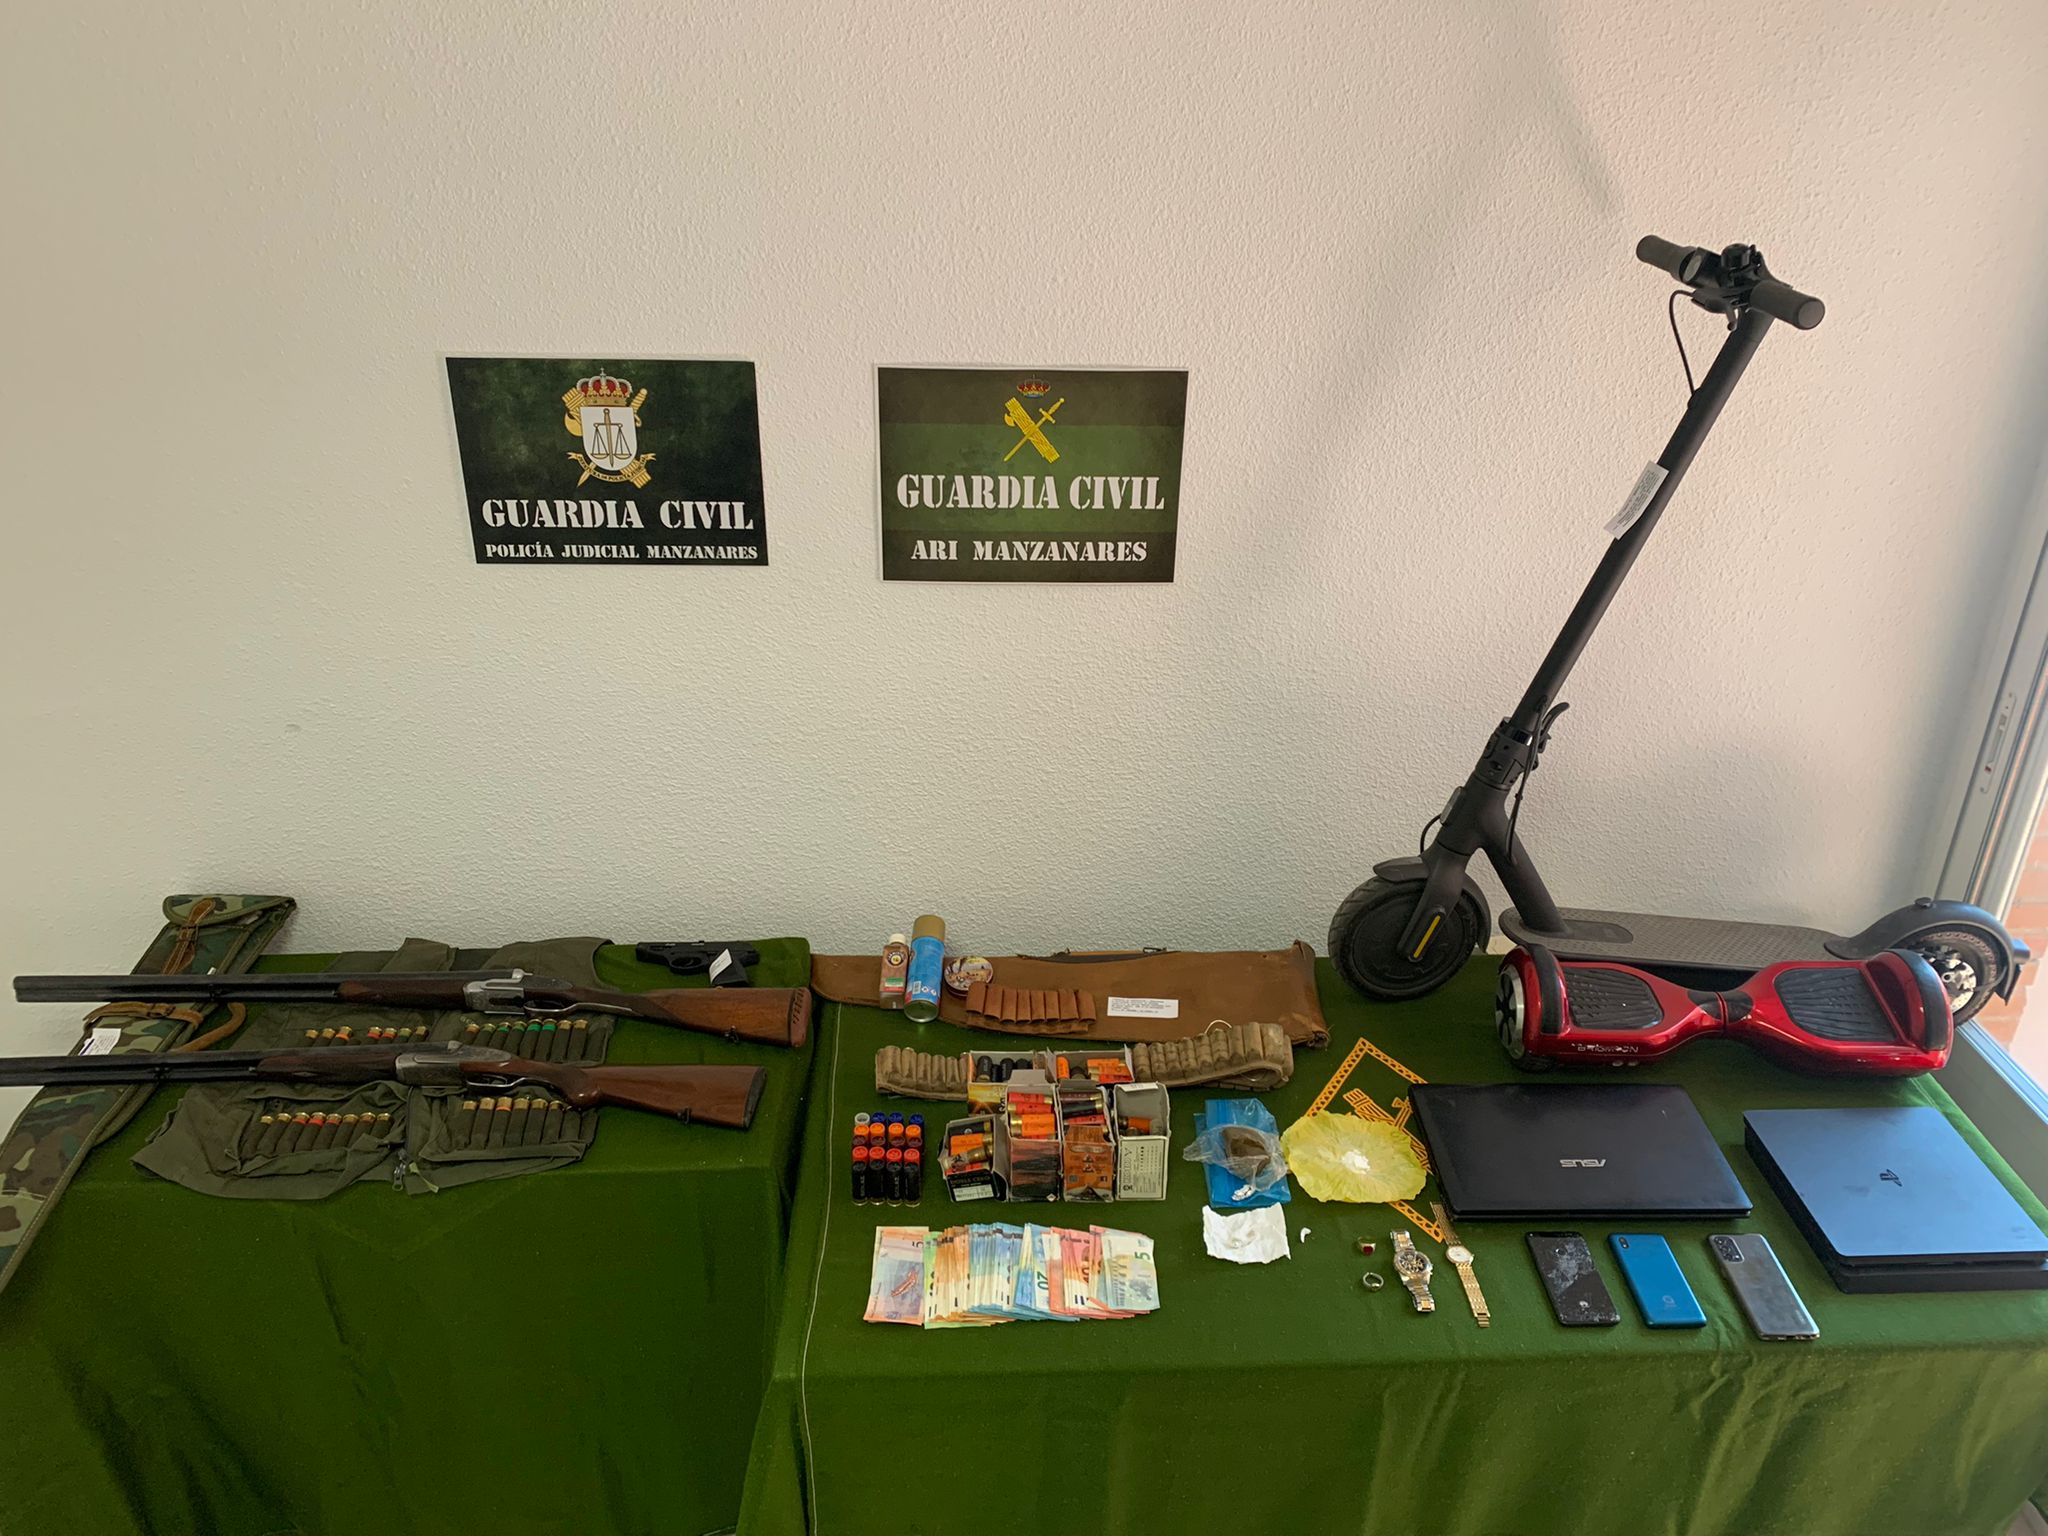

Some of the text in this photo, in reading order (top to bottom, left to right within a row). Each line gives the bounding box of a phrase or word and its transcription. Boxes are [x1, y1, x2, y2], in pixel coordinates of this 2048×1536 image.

[896, 473, 1165, 510] GUARDIA CIVIL
[481, 498, 754, 530] GUARDIA CIVIL
[485, 541, 758, 560] POLICÍA JUDICIAL MANZANARES
[910, 539, 1148, 562] ARI MANZANARES
[1560, 1159, 1607, 1168] ASUS
[1134, 1250, 1151, 1260] 5
